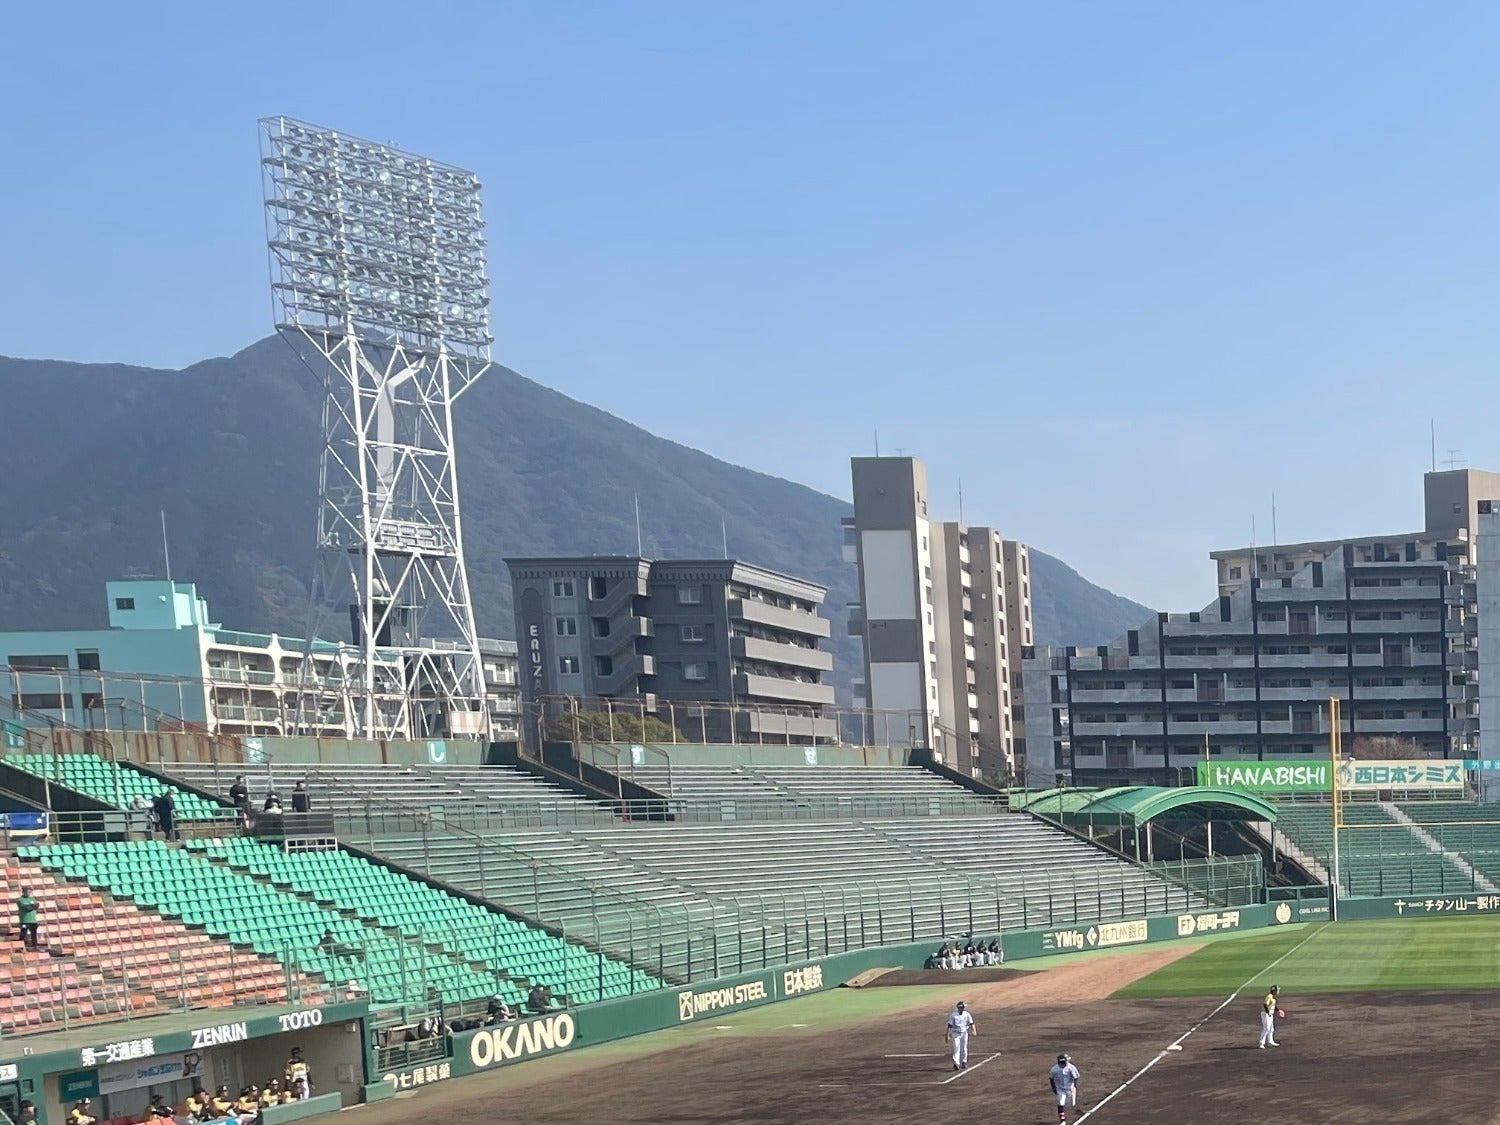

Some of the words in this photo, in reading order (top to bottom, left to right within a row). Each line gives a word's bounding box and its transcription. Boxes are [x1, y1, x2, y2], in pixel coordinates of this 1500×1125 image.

[430, 743, 444, 762] し
[1215, 765, 1326, 786] HANABISHI
[1355, 764, 1461, 784] 西日本シミズ
[1055, 930, 1084, 949] YMfg
[1101, 923, 1146, 942] 北九州銀行
[783, 964, 824, 996] 日本製鉄
[693, 986, 735, 1013] NIPPON
[735, 980, 768, 1004] STEEL
[278, 1008, 323, 1032] TOTO
[191, 1021, 248, 1048] ZENRIN
[470, 1013, 575, 1067] OKANO
[82, 1037, 155, 1067] 第一交通産業
